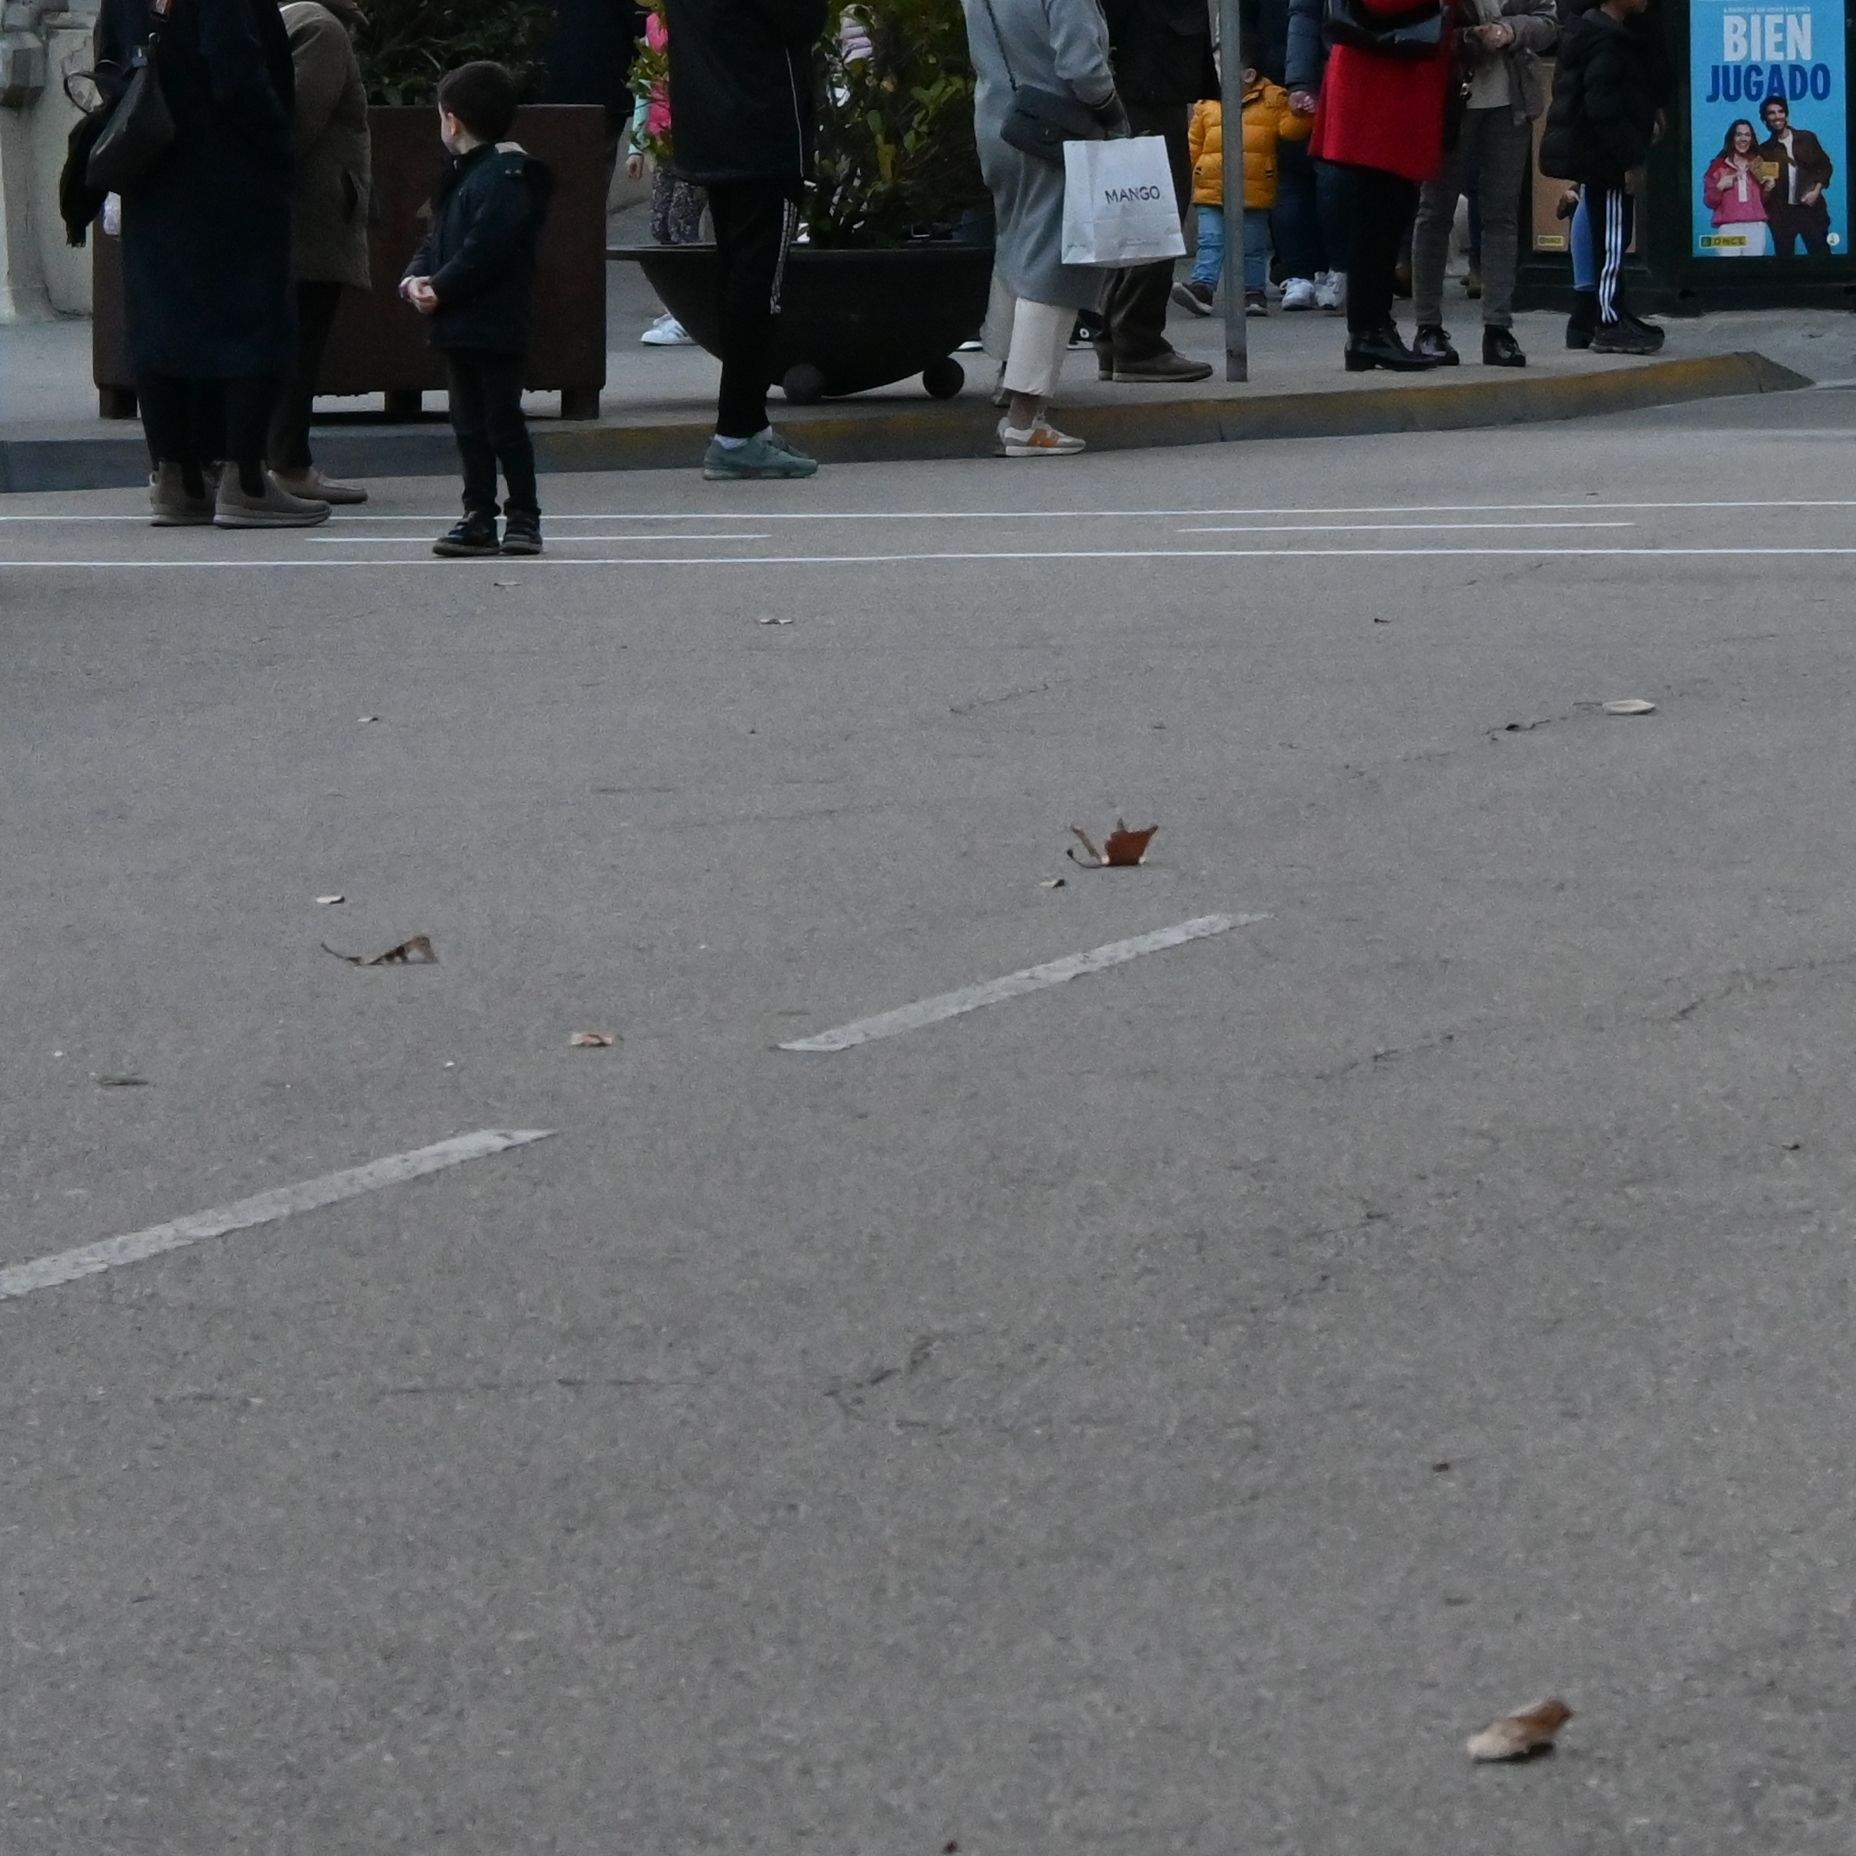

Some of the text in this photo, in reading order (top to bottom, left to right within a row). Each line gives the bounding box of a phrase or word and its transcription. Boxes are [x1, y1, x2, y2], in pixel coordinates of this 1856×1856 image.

[1723, 14, 1812, 62] BIEN
[1706, 63, 1831, 103] JUGADO
[1105, 185, 1161, 204] MANGO
